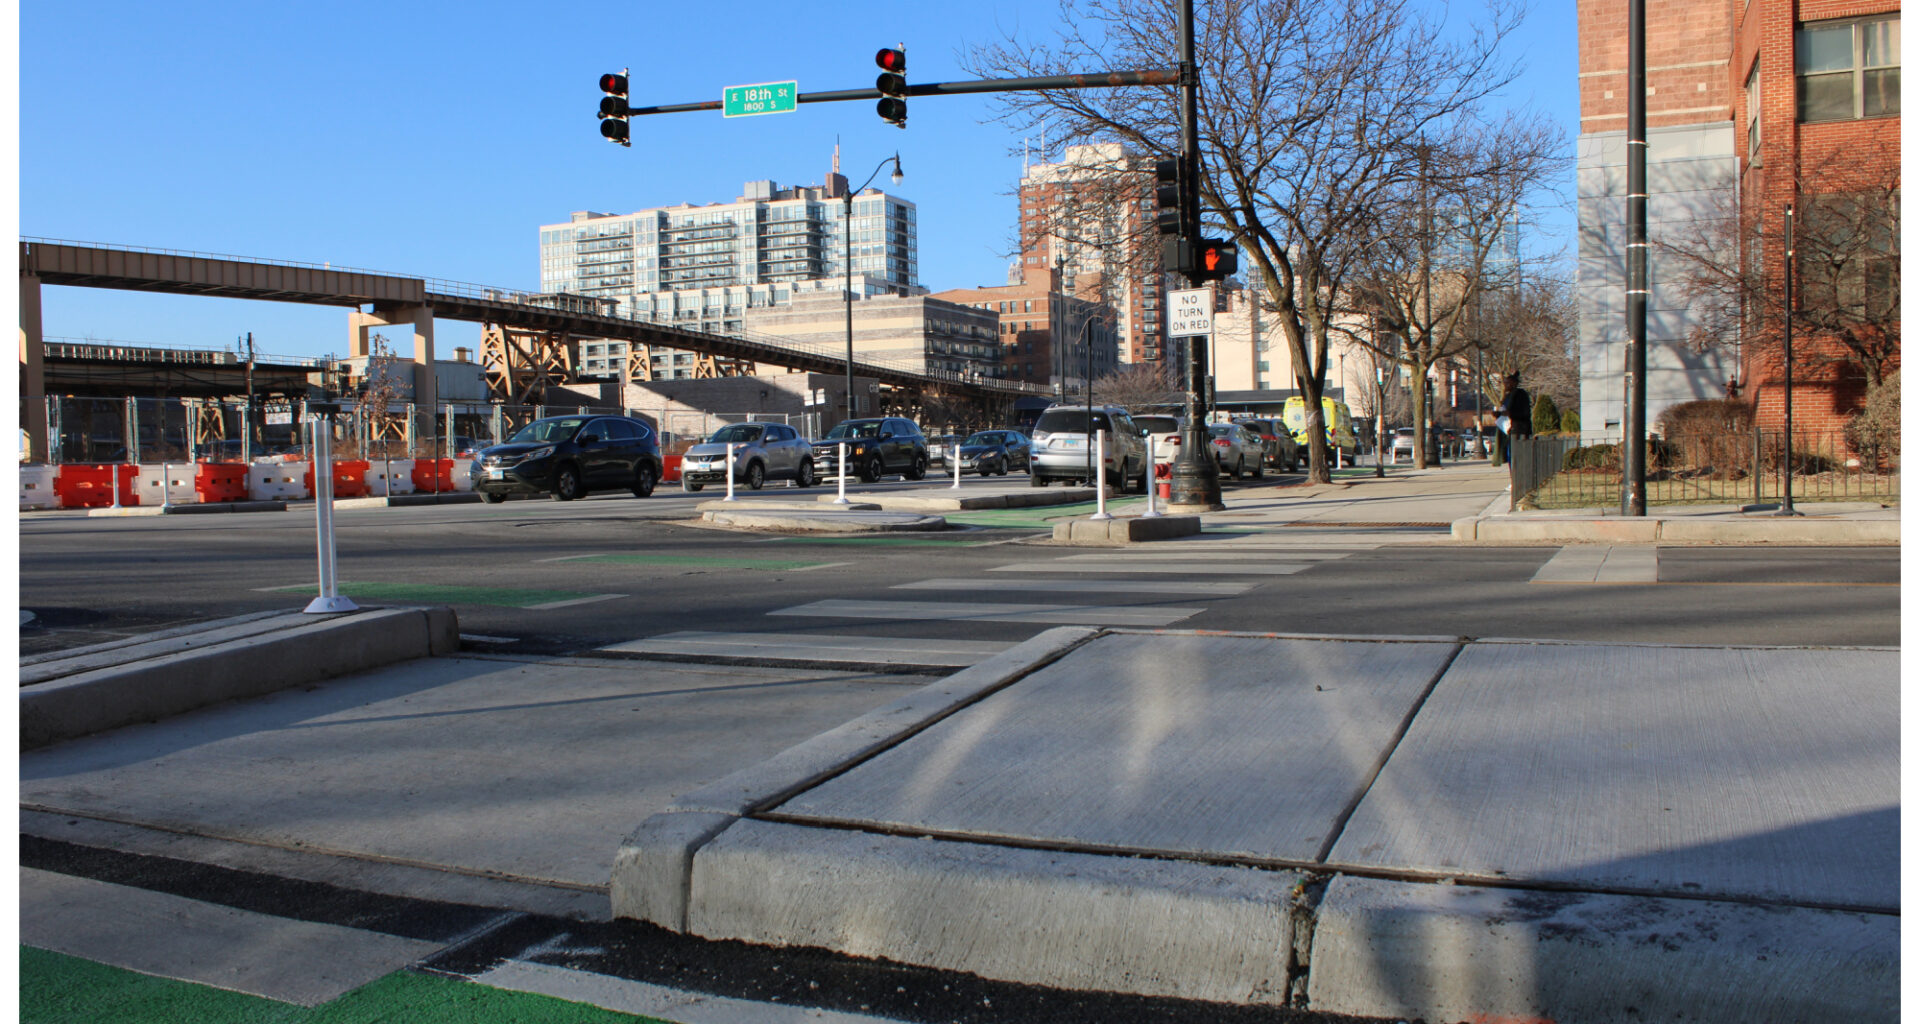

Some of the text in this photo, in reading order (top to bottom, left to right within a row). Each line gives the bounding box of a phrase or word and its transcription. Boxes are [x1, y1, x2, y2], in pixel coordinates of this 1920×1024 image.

[732, 89, 788, 102] E 18th St
[744, 100, 777, 111] 1800 S
[1182, 295, 1197, 304] NO
[1178, 307, 1203, 317] TURN
[1173, 320, 1209, 331] ON RED
